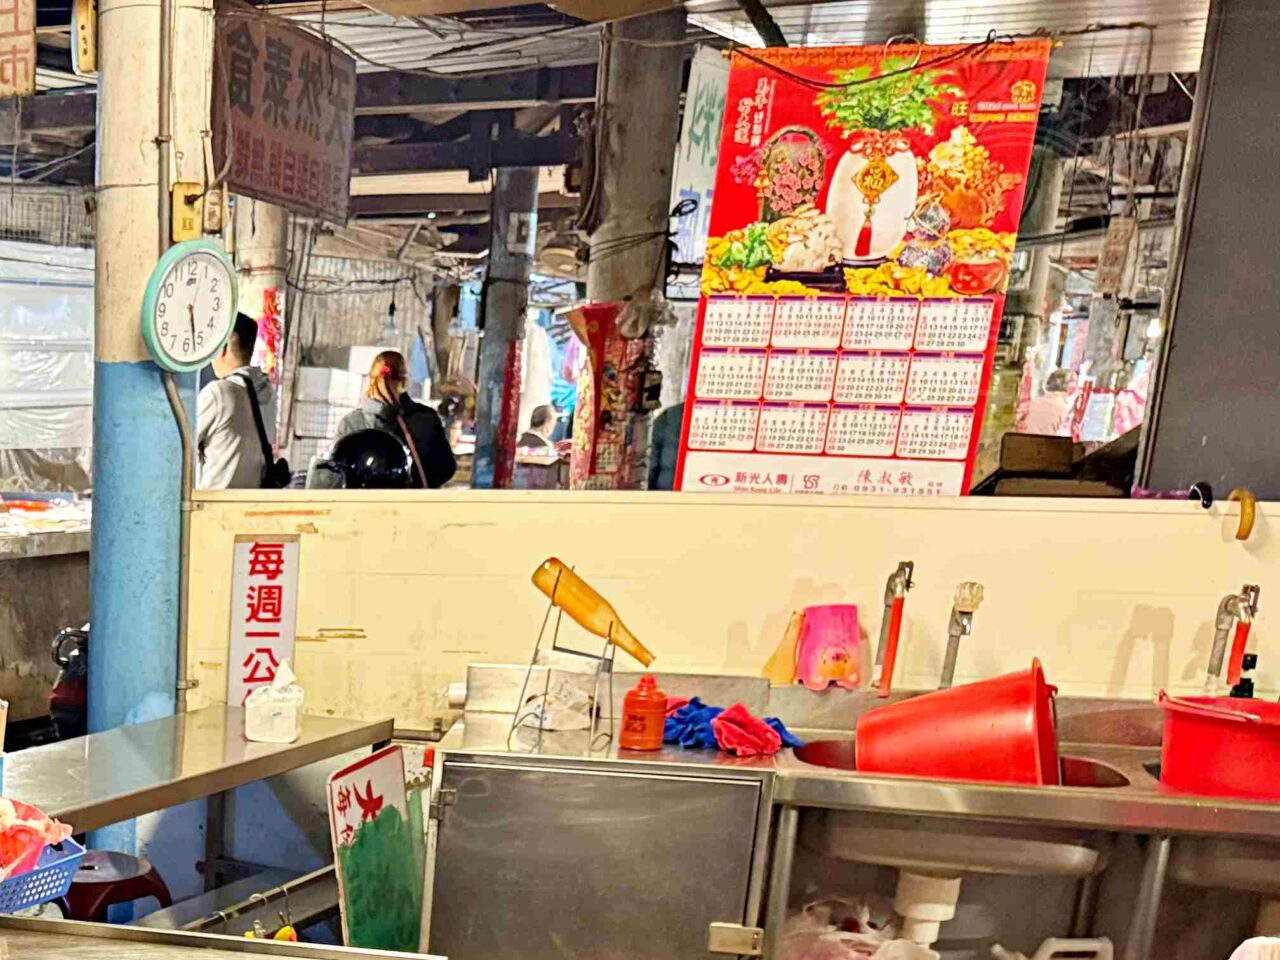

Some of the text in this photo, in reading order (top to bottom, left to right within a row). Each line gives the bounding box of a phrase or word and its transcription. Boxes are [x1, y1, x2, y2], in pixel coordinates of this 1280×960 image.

[175, 266, 183, 282] 11
[188, 261, 197, 276] 12
[163, 283, 174, 298] 10
[210, 278, 217, 292] 2
[158, 303, 166, 318] 9
[212, 297, 220, 311] 3
[160, 322, 168, 336] 8
[207, 316, 214, 329] 4
[170, 335, 177, 349] 7
[182, 338, 190, 352] 6
[197, 331, 204, 345] 5
[242, 541, 284, 706] 每週一公
